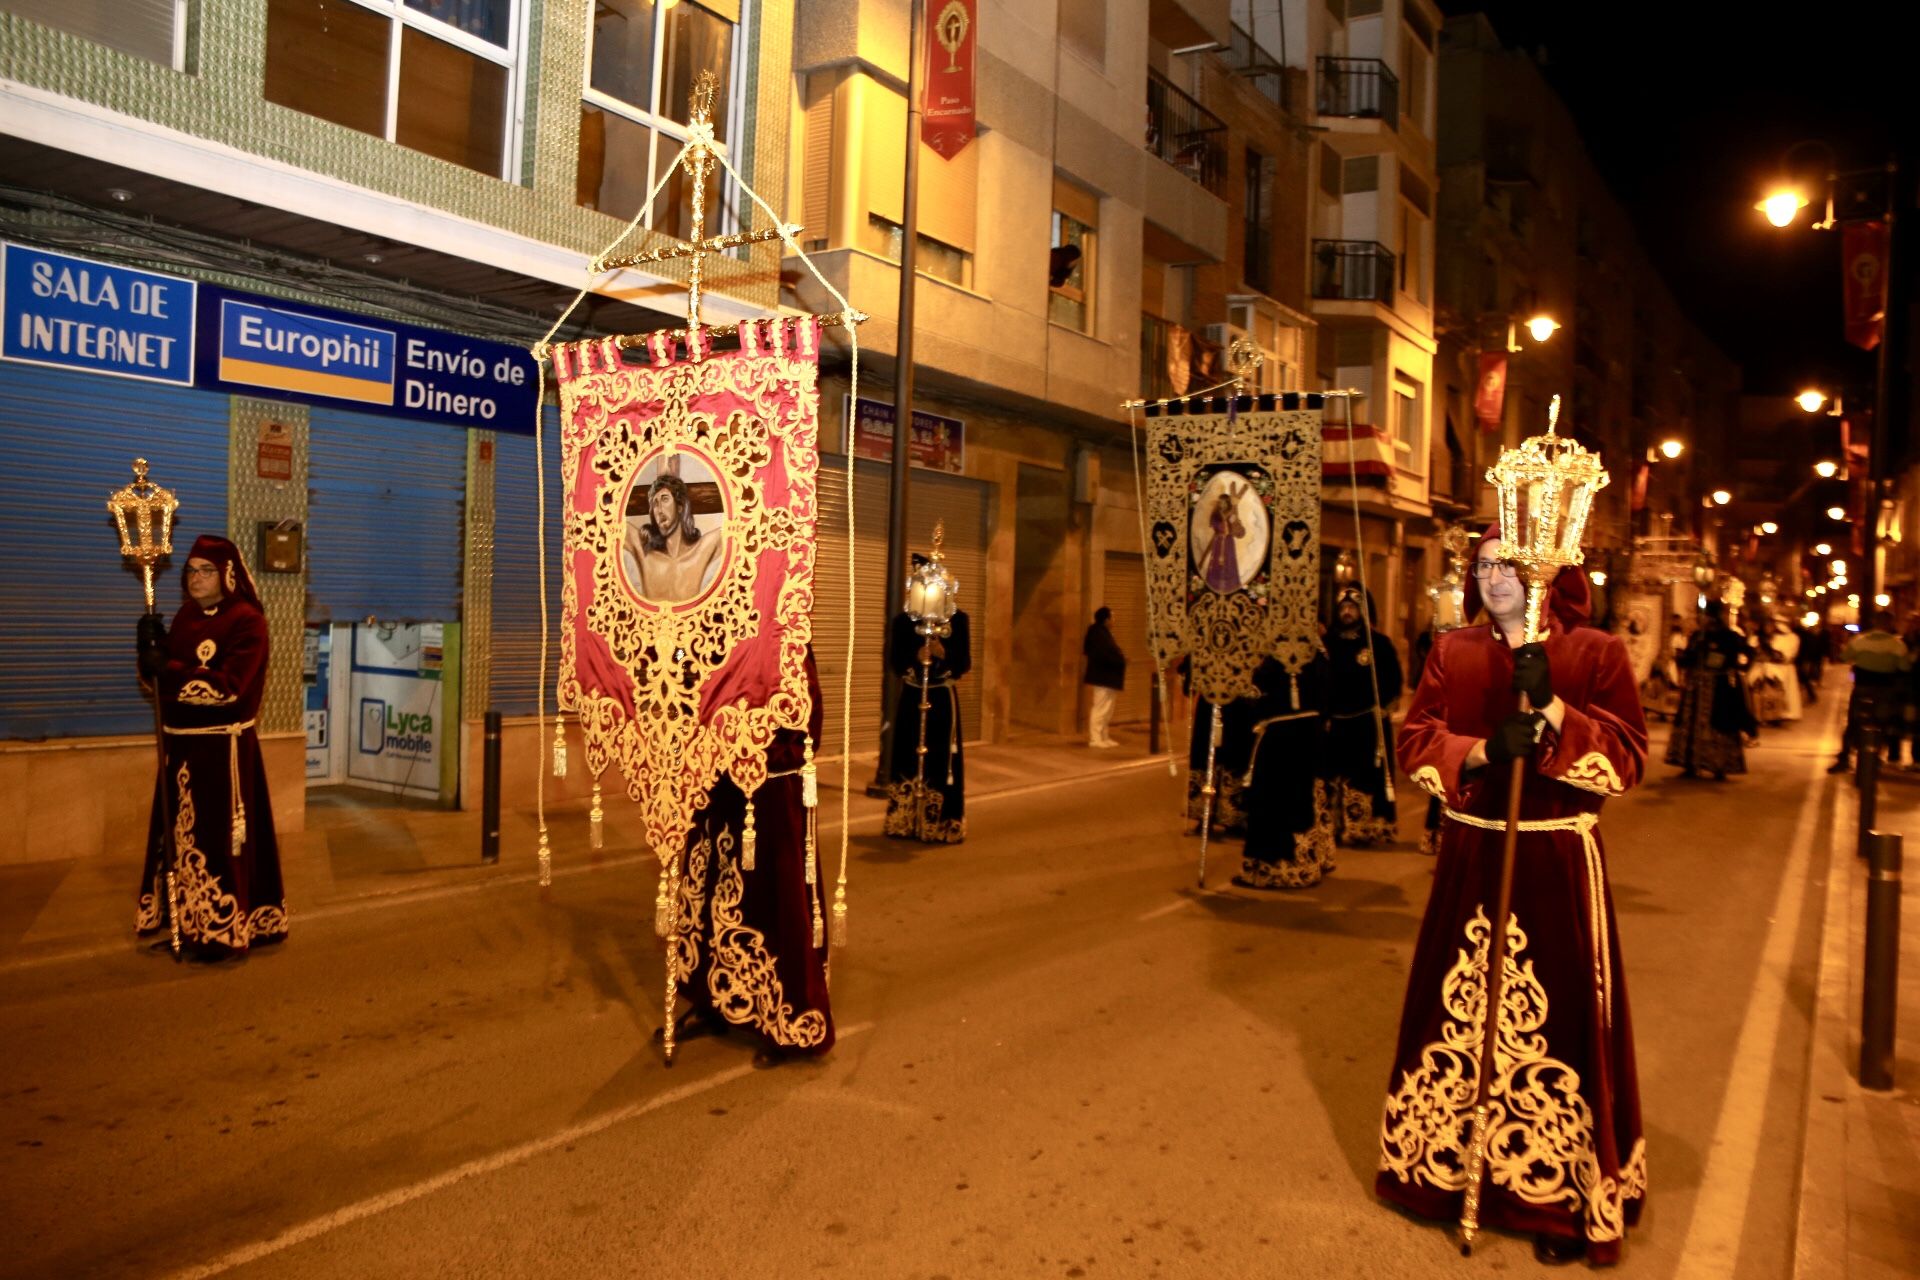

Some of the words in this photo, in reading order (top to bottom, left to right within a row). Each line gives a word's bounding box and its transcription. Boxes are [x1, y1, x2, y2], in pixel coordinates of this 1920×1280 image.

[32, 261, 120, 311] SALA
[131, 281, 168, 320] DE
[20, 313, 176, 370] INTERNET
[239, 315, 380, 369] Europhil
[406, 339, 486, 379] Envío
[494, 357, 525, 386] de
[405, 380, 497, 420] Dinero
[386, 704, 433, 736] Lyca
[386, 734, 433, 753] mobile
